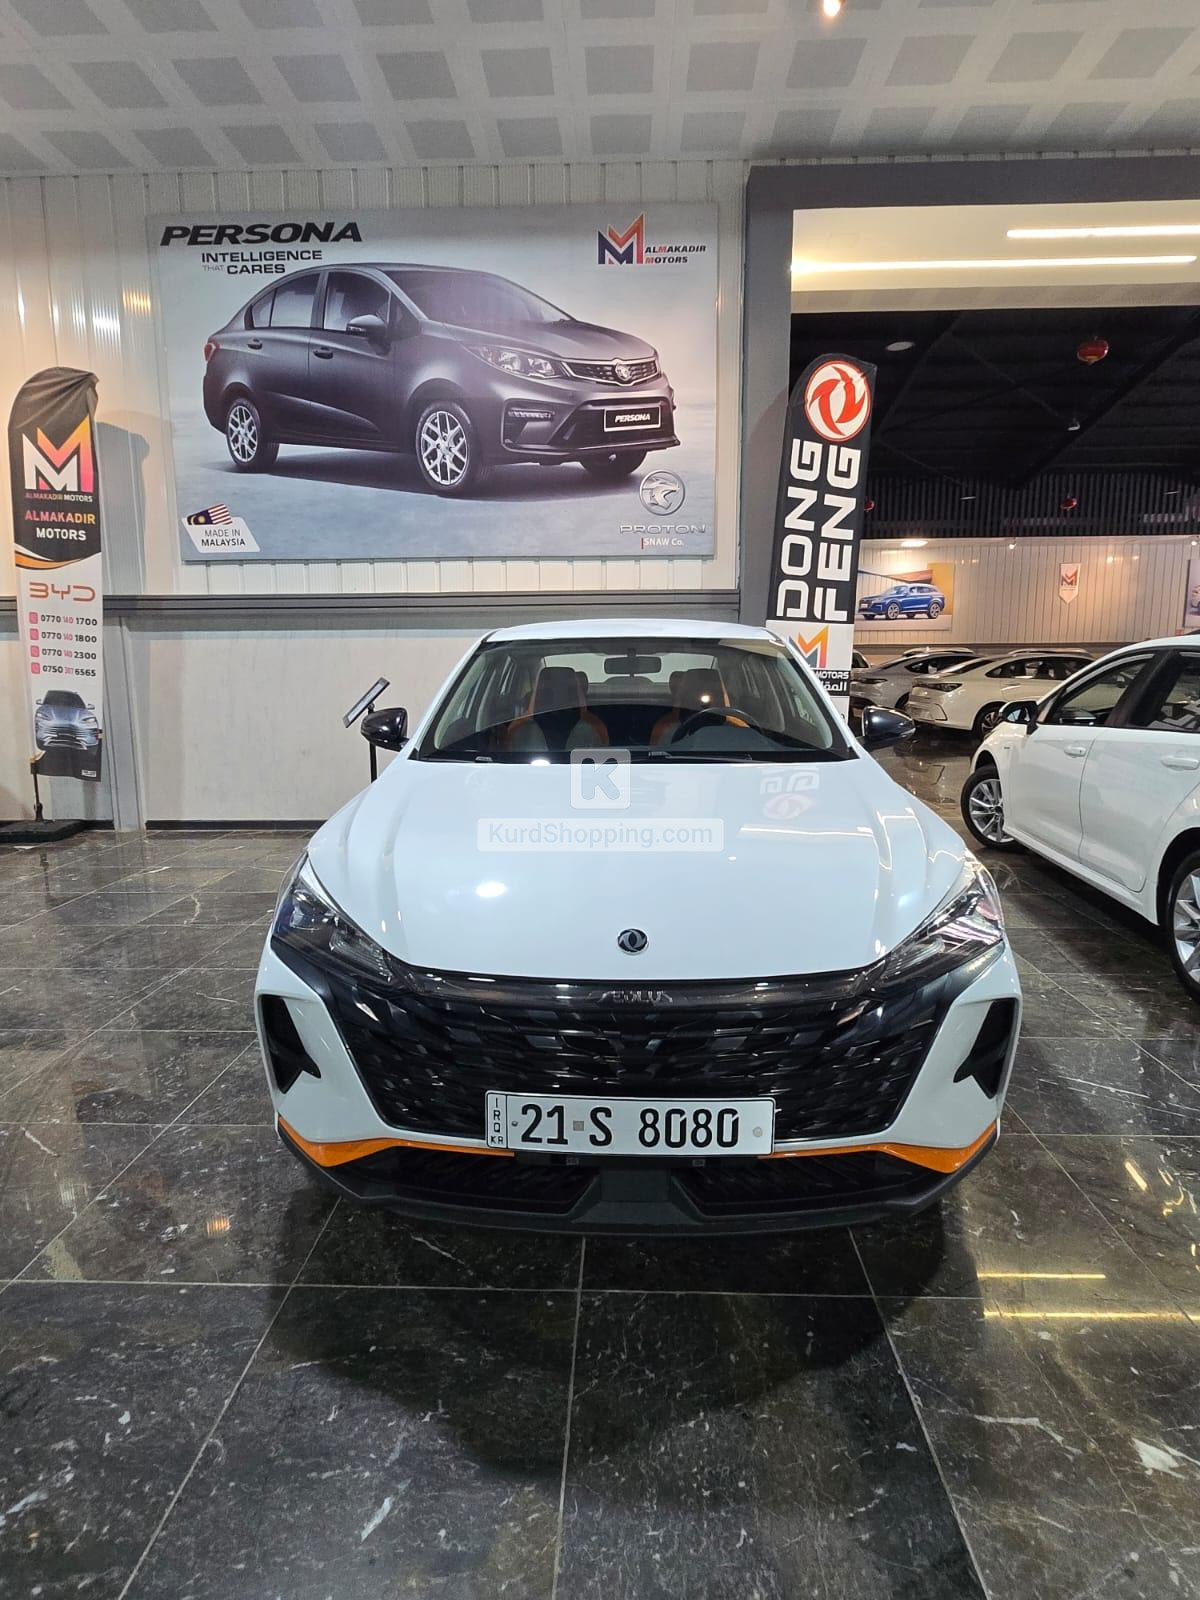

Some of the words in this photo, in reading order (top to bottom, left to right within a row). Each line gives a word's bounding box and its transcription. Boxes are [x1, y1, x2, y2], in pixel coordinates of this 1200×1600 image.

[160, 222, 362, 246] PERSONA
[645, 245, 706, 253] ALMAKADIR
[202, 250, 322, 263] INTELLIGENCE
[645, 256, 688, 264] MOTORS
[227, 263, 286, 275] CARES
[615, 413, 651, 423] PERSONA
[64, 494, 93, 502] MOTORS
[24, 510, 96, 525] ALMAKADIR
[36, 527, 87, 541] MOTORS
[205, 529, 229, 537] MADE
[232, 529, 240, 537] IN
[620, 525, 706, 534] PROTON
[776, 438, 823, 618] DONG
[813, 444, 861, 621] FENG
[29, 582, 96, 602] BYD
[40, 614, 62, 623] 0770
[75, 617, 98, 626] 1700
[41, 631, 62, 639] 0770
[75, 634, 97, 643] 1800
[41, 648, 62, 657] 0770
[74, 651, 97, 660] 2300
[42, 665, 64, 673] 0750
[521, 1104, 568, 1145] 21
[589, 1107, 613, 1147] S
[638, 1108, 739, 1148] 8080
